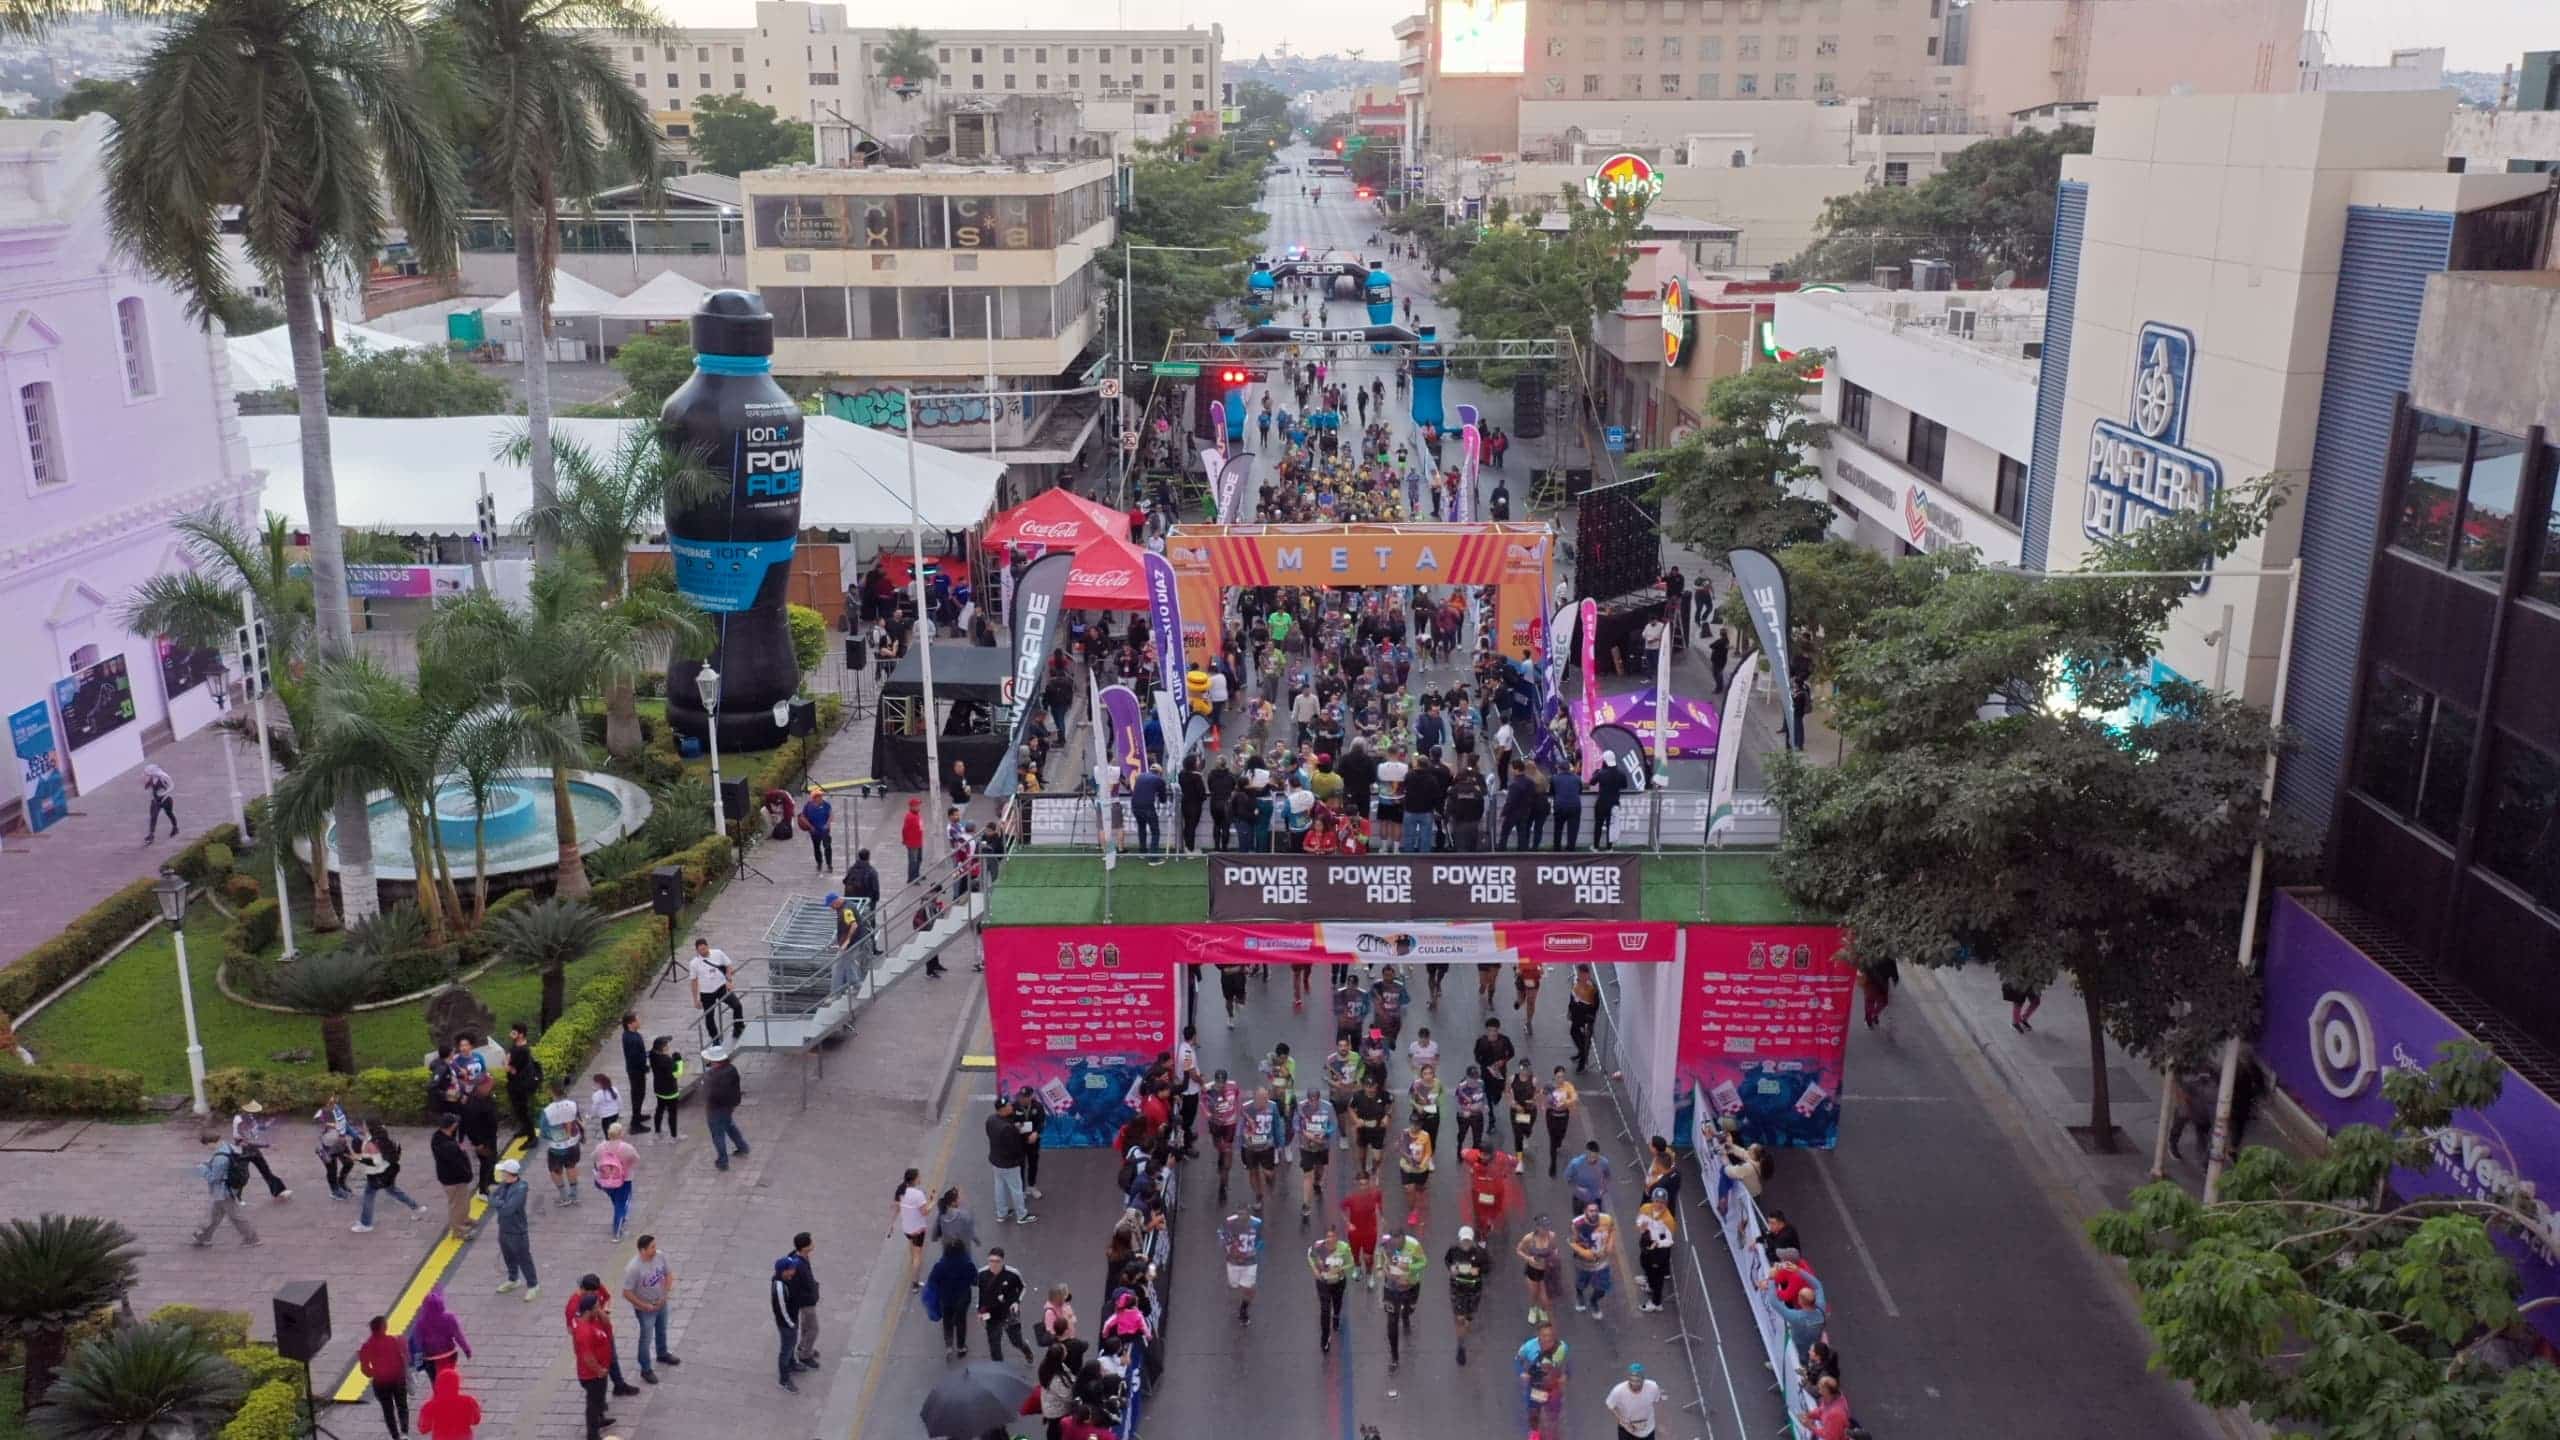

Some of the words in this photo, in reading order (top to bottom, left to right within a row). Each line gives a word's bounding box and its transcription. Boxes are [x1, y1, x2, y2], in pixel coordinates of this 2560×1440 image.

[1296, 264, 1345, 275] SALIDA
[1289, 330, 1366, 344] SALIDA
[2088, 433, 2206, 514] PAPELERA
[2085, 483, 2122, 537] DEL
[1019, 519, 1082, 539] Coca-Cola
[1276, 547, 1439, 571] META
[1224, 866, 1308, 885] POWER
[1328, 866, 1412, 885] POWER
[1432, 866, 1516, 885] POWER
[1537, 866, 1621, 885] POWER
[1262, 886, 1310, 904] ADE
[1366, 886, 1414, 904] ADE
[1470, 886, 1518, 904] ADE
[1575, 886, 1623, 904] ADE
